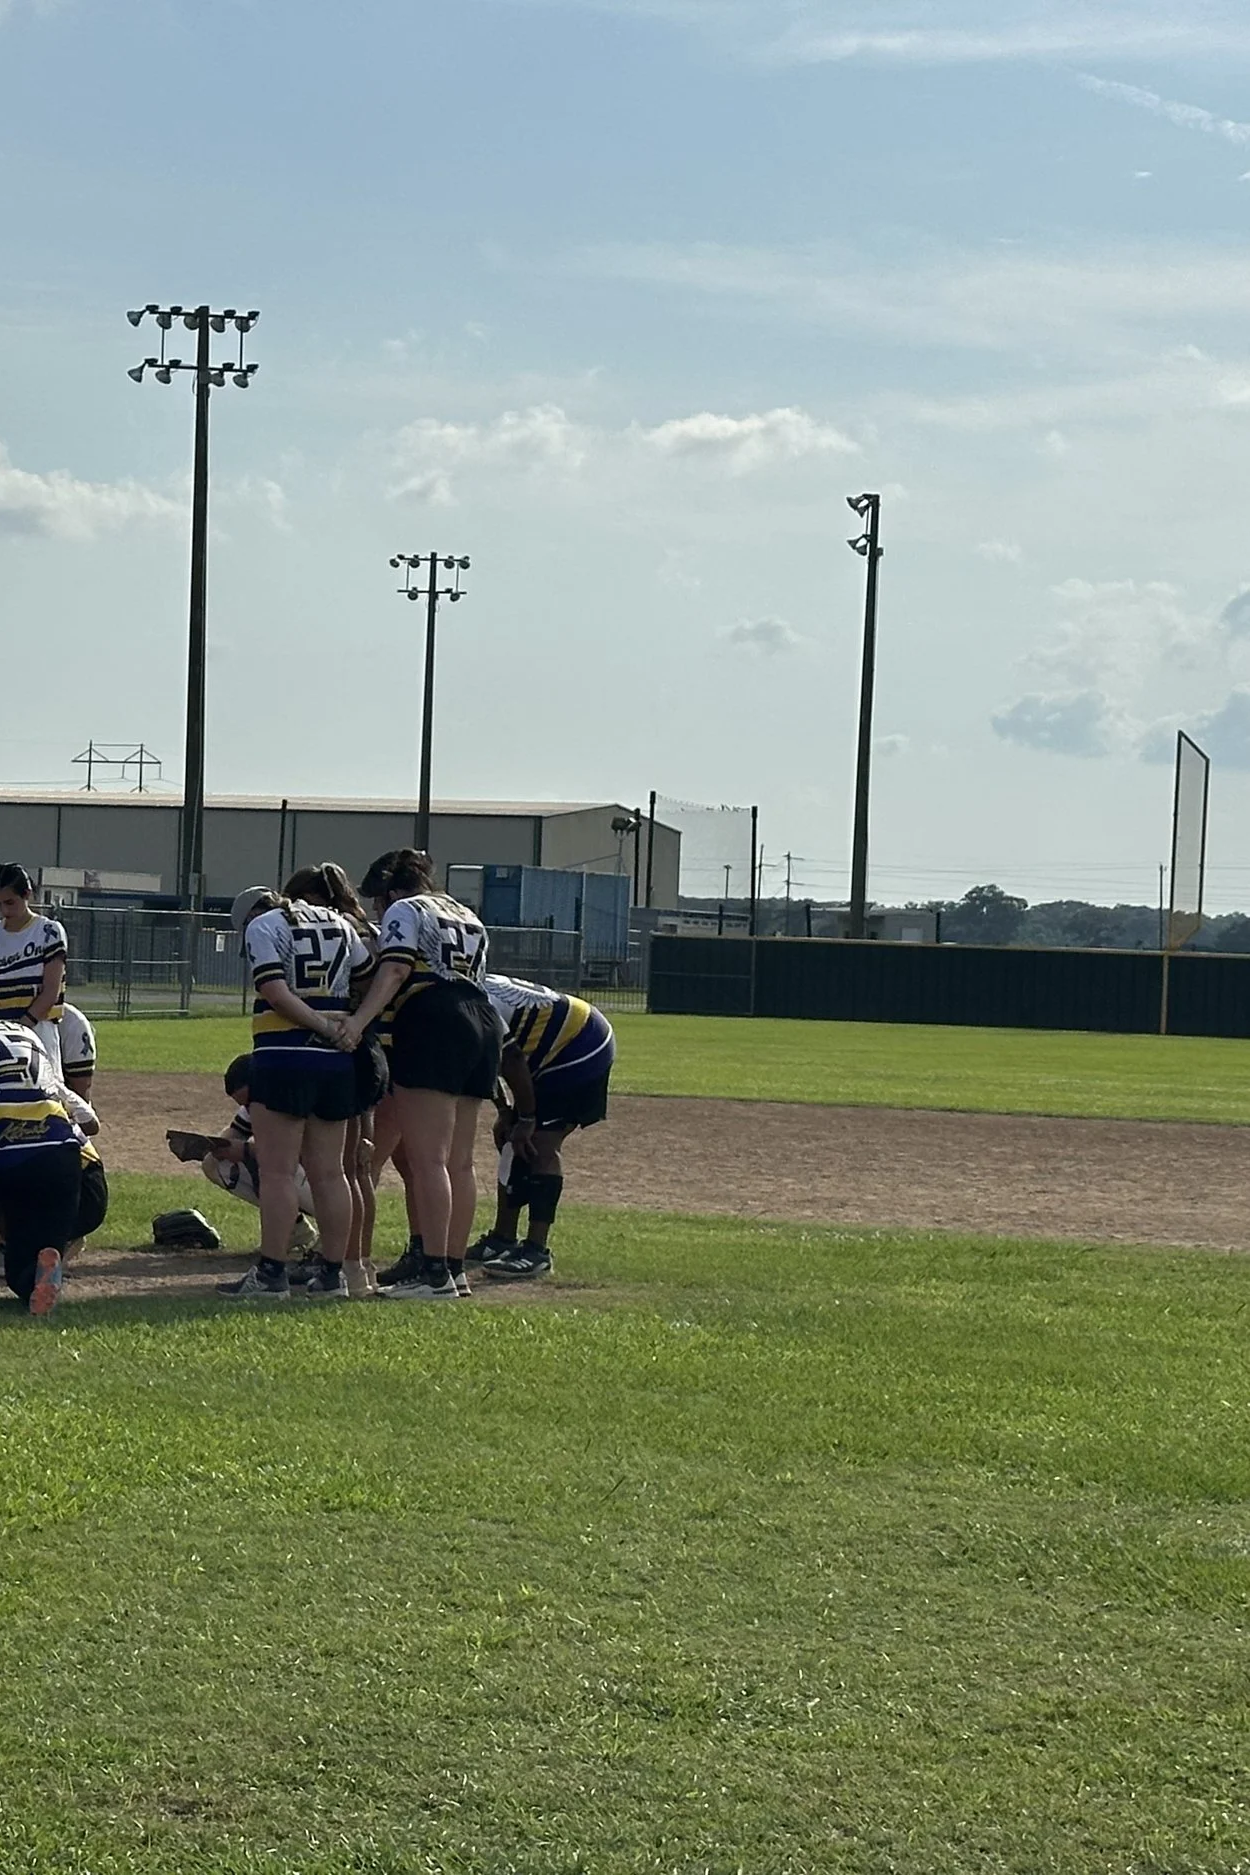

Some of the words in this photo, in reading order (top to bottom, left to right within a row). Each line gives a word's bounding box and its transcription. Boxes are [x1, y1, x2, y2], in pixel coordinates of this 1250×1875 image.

[24, 941, 44, 957] On
[291, 928, 348, 989] 27
[437, 916, 485, 980] 27
